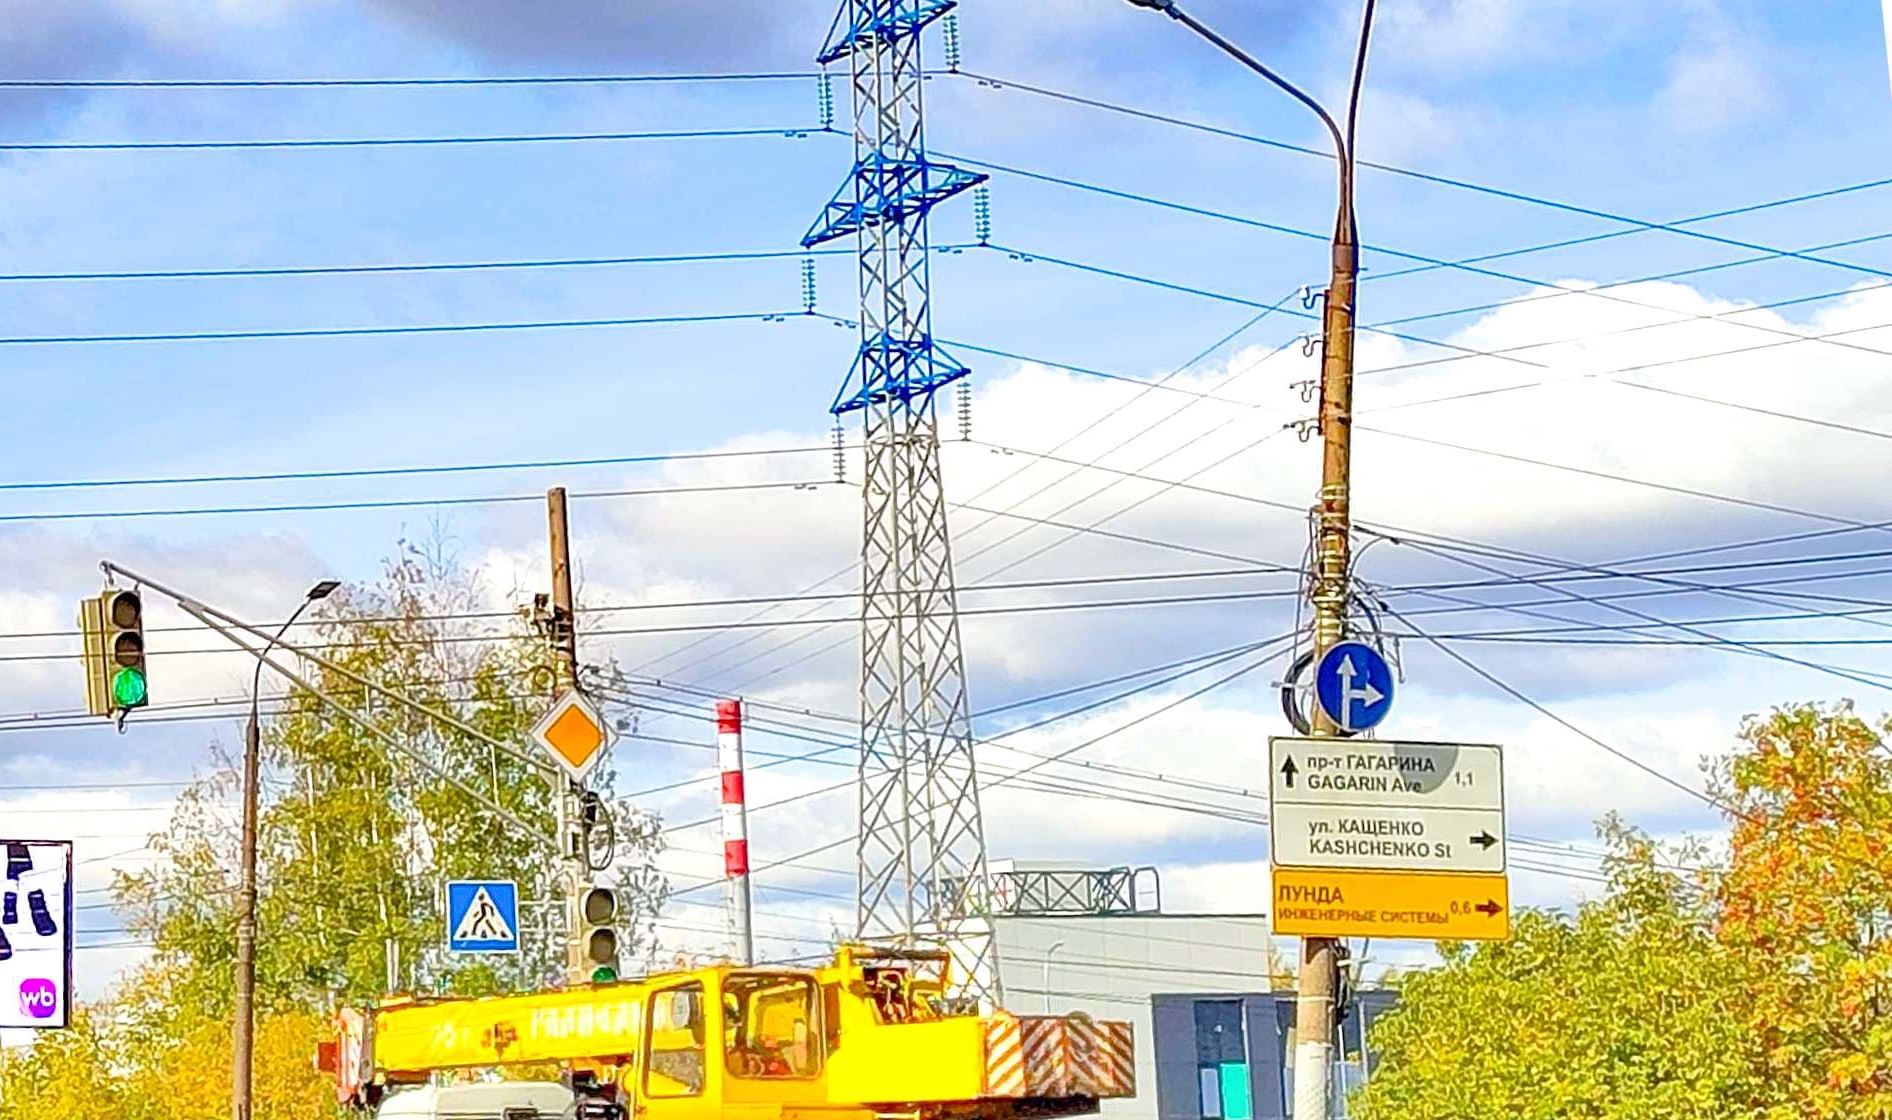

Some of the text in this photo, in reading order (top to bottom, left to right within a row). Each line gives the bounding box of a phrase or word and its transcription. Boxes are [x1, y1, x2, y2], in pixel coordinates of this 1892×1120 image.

[1308, 754, 1435, 773] пр-т ГАГАРИНА
[1308, 774, 1422, 793] GAGARIN Ave
[1455, 772, 1473, 787] 1,1
[1308, 819, 1424, 838] ул. КАЩЕНКО
[1309, 839, 1451, 858] KASHCHENKO St
[1278, 885, 1344, 905] ЛУНДА
[1278, 908, 1449, 924] ИНЖЕНЕРНЫЕ СИСТЕМЫ
[21, 985, 55, 1007] wb
